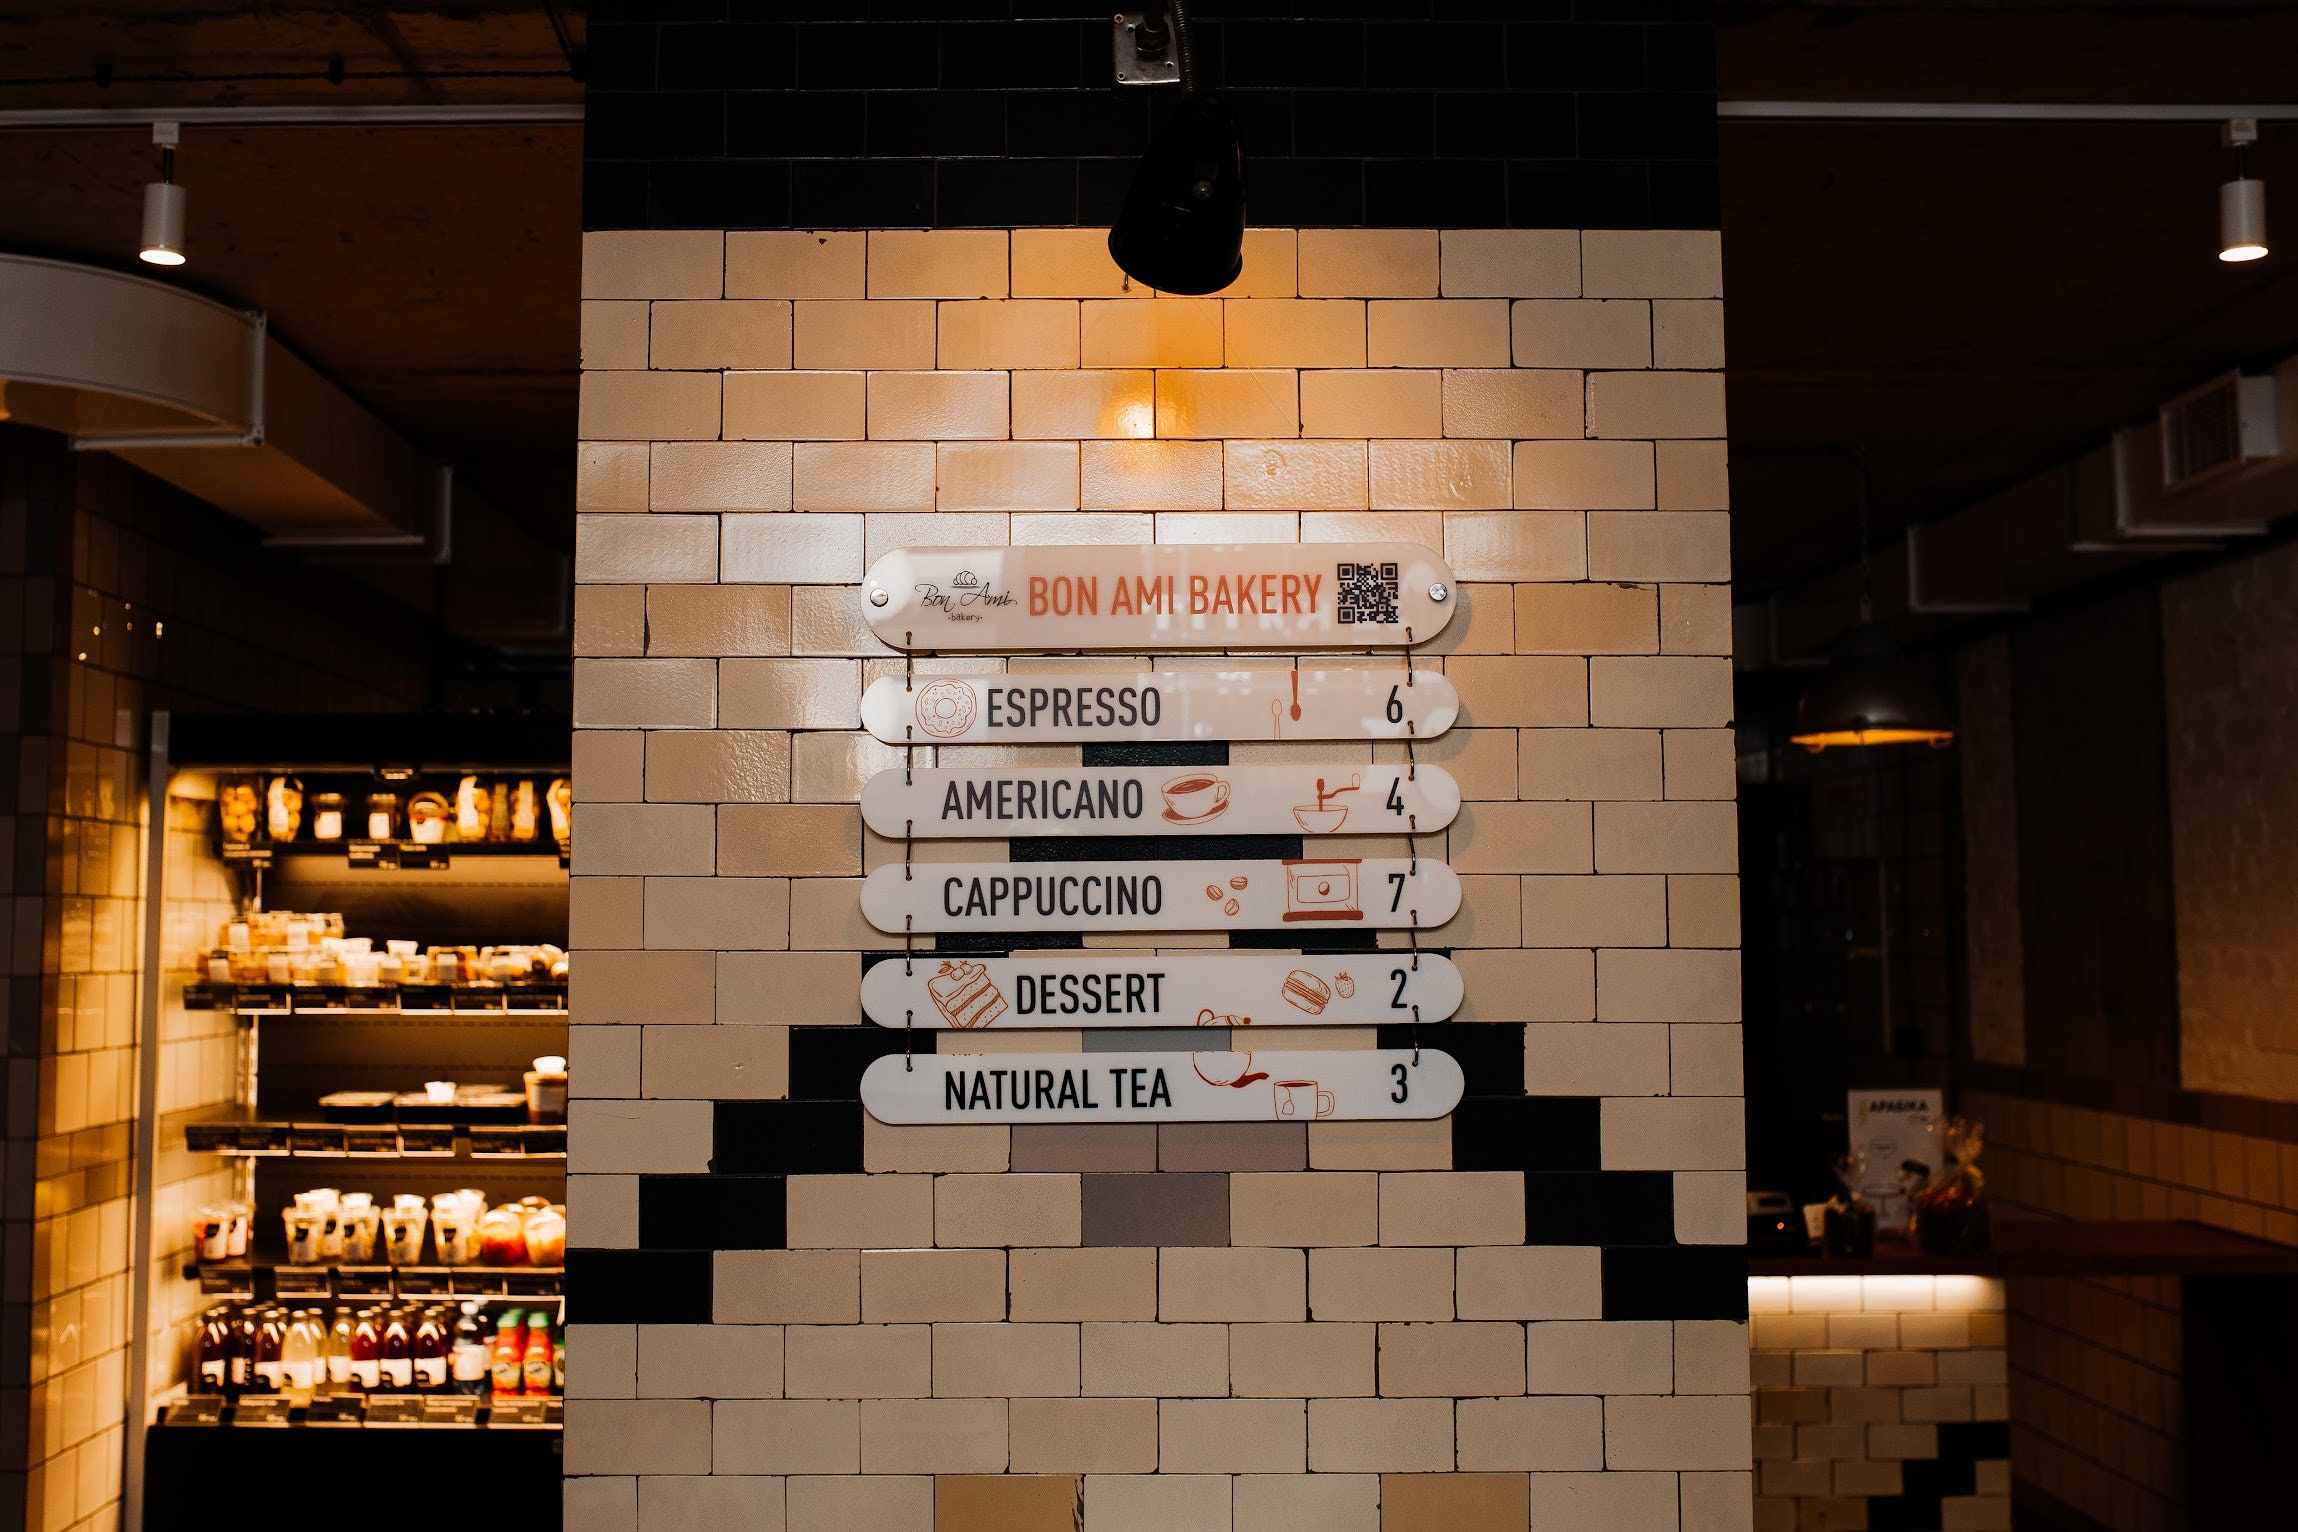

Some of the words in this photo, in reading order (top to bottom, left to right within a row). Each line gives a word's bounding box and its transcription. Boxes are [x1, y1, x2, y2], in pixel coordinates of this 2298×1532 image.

[914, 583, 955, 612] Bon
[960, 582, 1017, 607] Ami
[1028, 576, 1098, 616] BON
[1110, 575, 1174, 615] AMI
[1188, 574, 1323, 615] BAKERY
[987, 687, 1161, 728] ESPRESSO
[1386, 685, 1403, 724] 6
[941, 779, 1143, 820] AMERICANO
[1386, 778, 1404, 816] 4
[943, 875, 1162, 917] CAPPUCCINO
[1388, 874, 1406, 913] 7
[1016, 973, 1166, 1015] DESSERT
[1390, 969, 1408, 1009] 2
[945, 1069, 1099, 1111] NATURAL
[1109, 1067, 1172, 1108] TEA
[1390, 1064, 1408, 1104] 3
